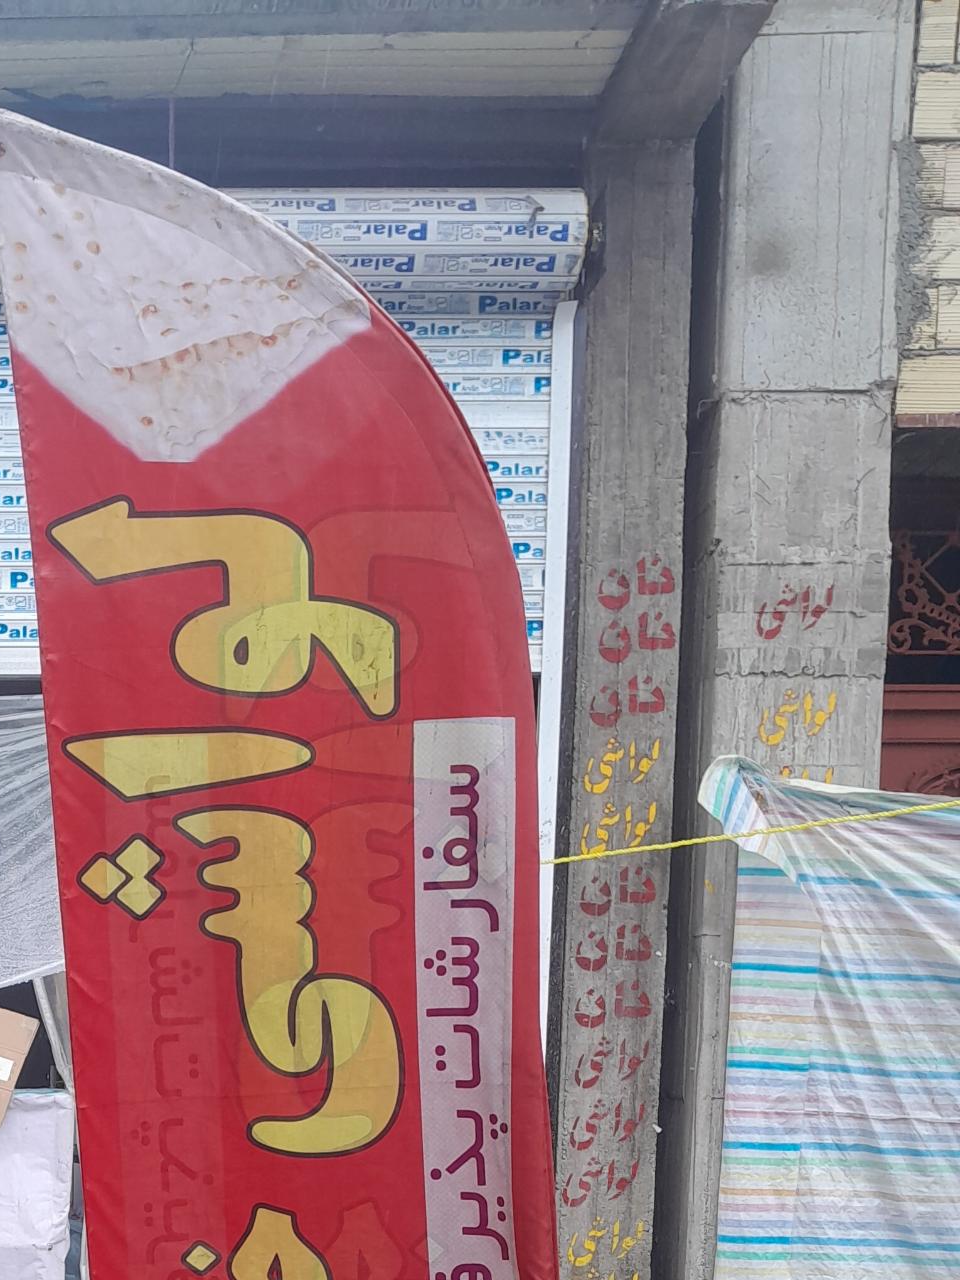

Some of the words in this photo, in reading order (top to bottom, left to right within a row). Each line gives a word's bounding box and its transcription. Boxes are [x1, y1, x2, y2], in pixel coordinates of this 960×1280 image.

[478, 295, 541, 313] Palar
[502, 349, 552, 365] Pala
[496, 488, 547, 504] Pala
[45, 495, 405, 1157] لواشی
[423, 764, 500, 1089] سفارشات
